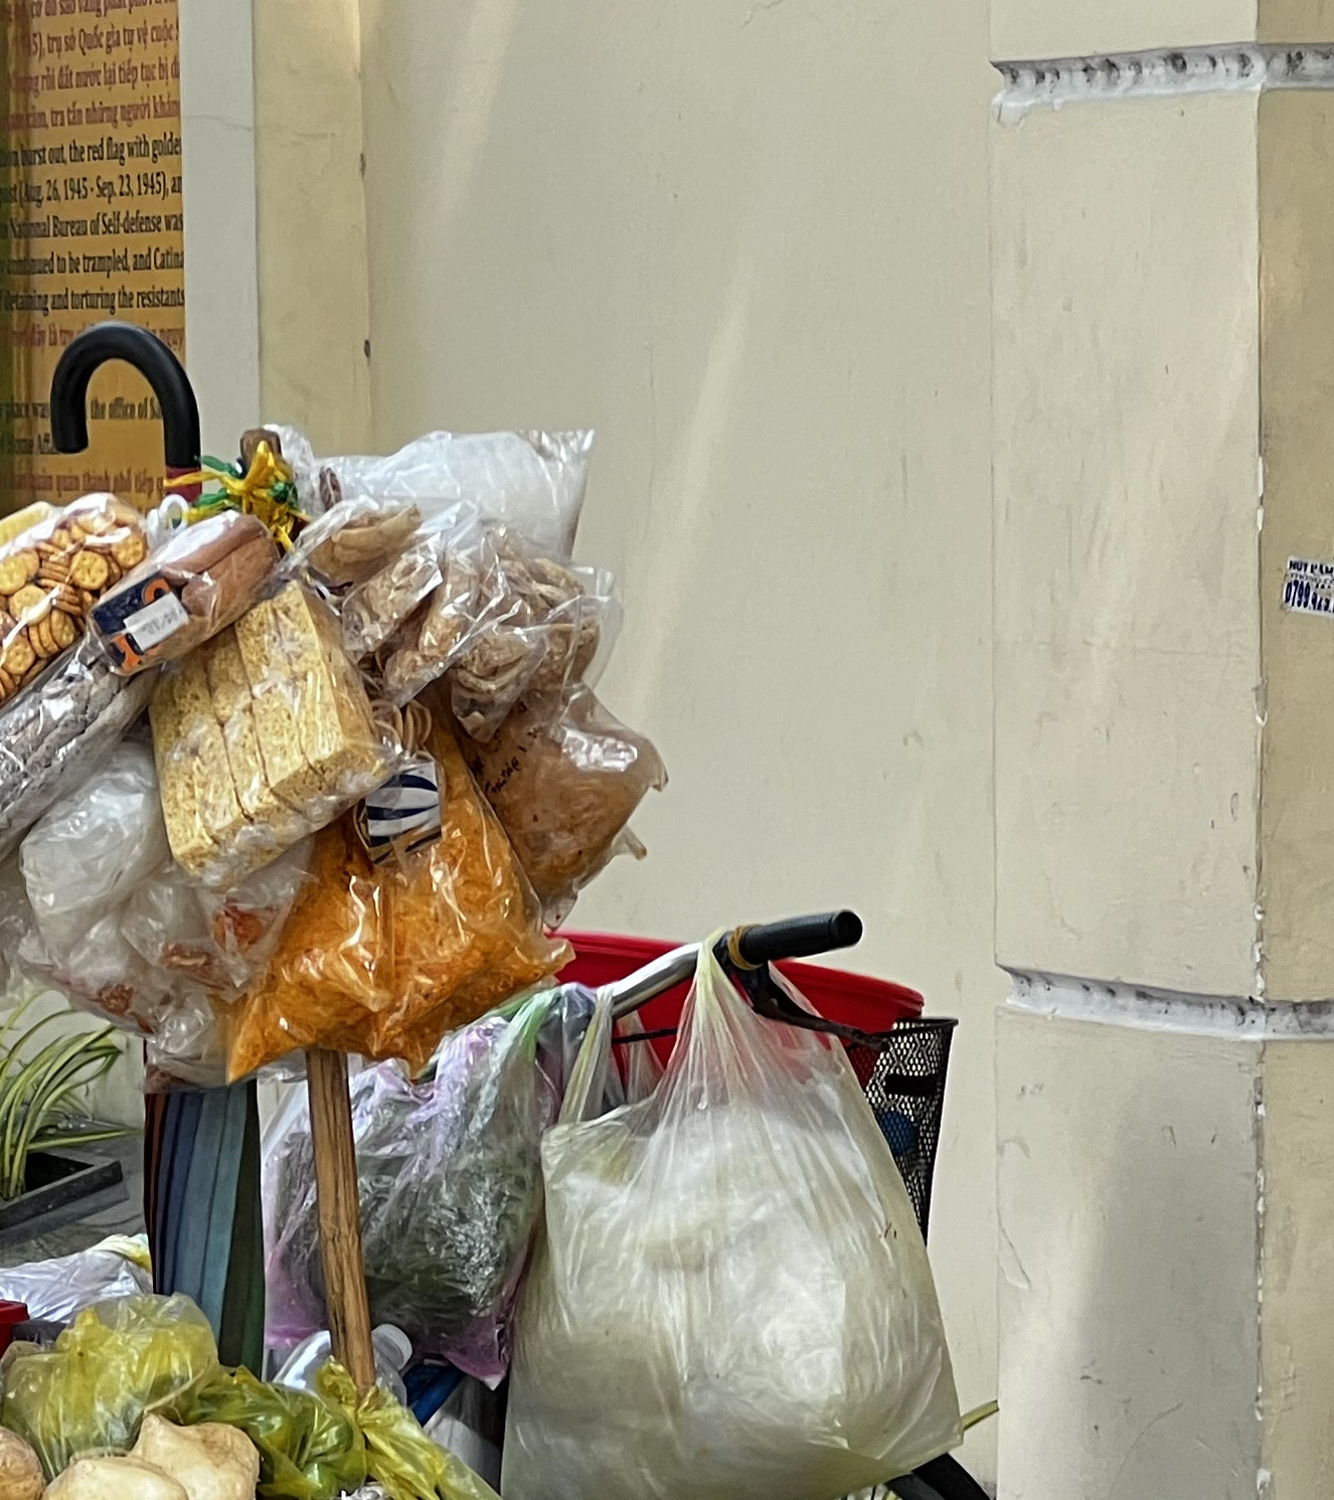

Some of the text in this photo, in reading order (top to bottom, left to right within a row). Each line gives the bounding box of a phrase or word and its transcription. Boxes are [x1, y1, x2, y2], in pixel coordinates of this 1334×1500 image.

[48, 145, 67, 166] out,
[68, 138, 85, 163] the
[87, 135, 104, 162] red
[106, 136, 125, 166] flag
[127, 133, 150, 158] with
[46, 179, 61, 203] 26,
[63, 176, 88, 201] 1945
[96, 174, 117, 205] Sep.
[119, 173, 135, 199] 23,
[137, 171, 168, 202] 1945),
[53, 215, 88, 238] Bureau
[90, 212, 101, 236] of
[102, 209, 163, 235] Self-defense
[164, 213, 184, 233] was
[57, 254, 67, 274] to
[68, 251, 80, 274] be
[82, 247, 130, 280] trampled,
[132, 245, 151, 271] and
[51, 287, 69, 311] and
[70, 284, 116, 316] torturing
[118, 283, 134, 309] the
[90, 396, 106, 420] the
[108, 396, 136, 421] office
[137, 396, 148, 420] of
